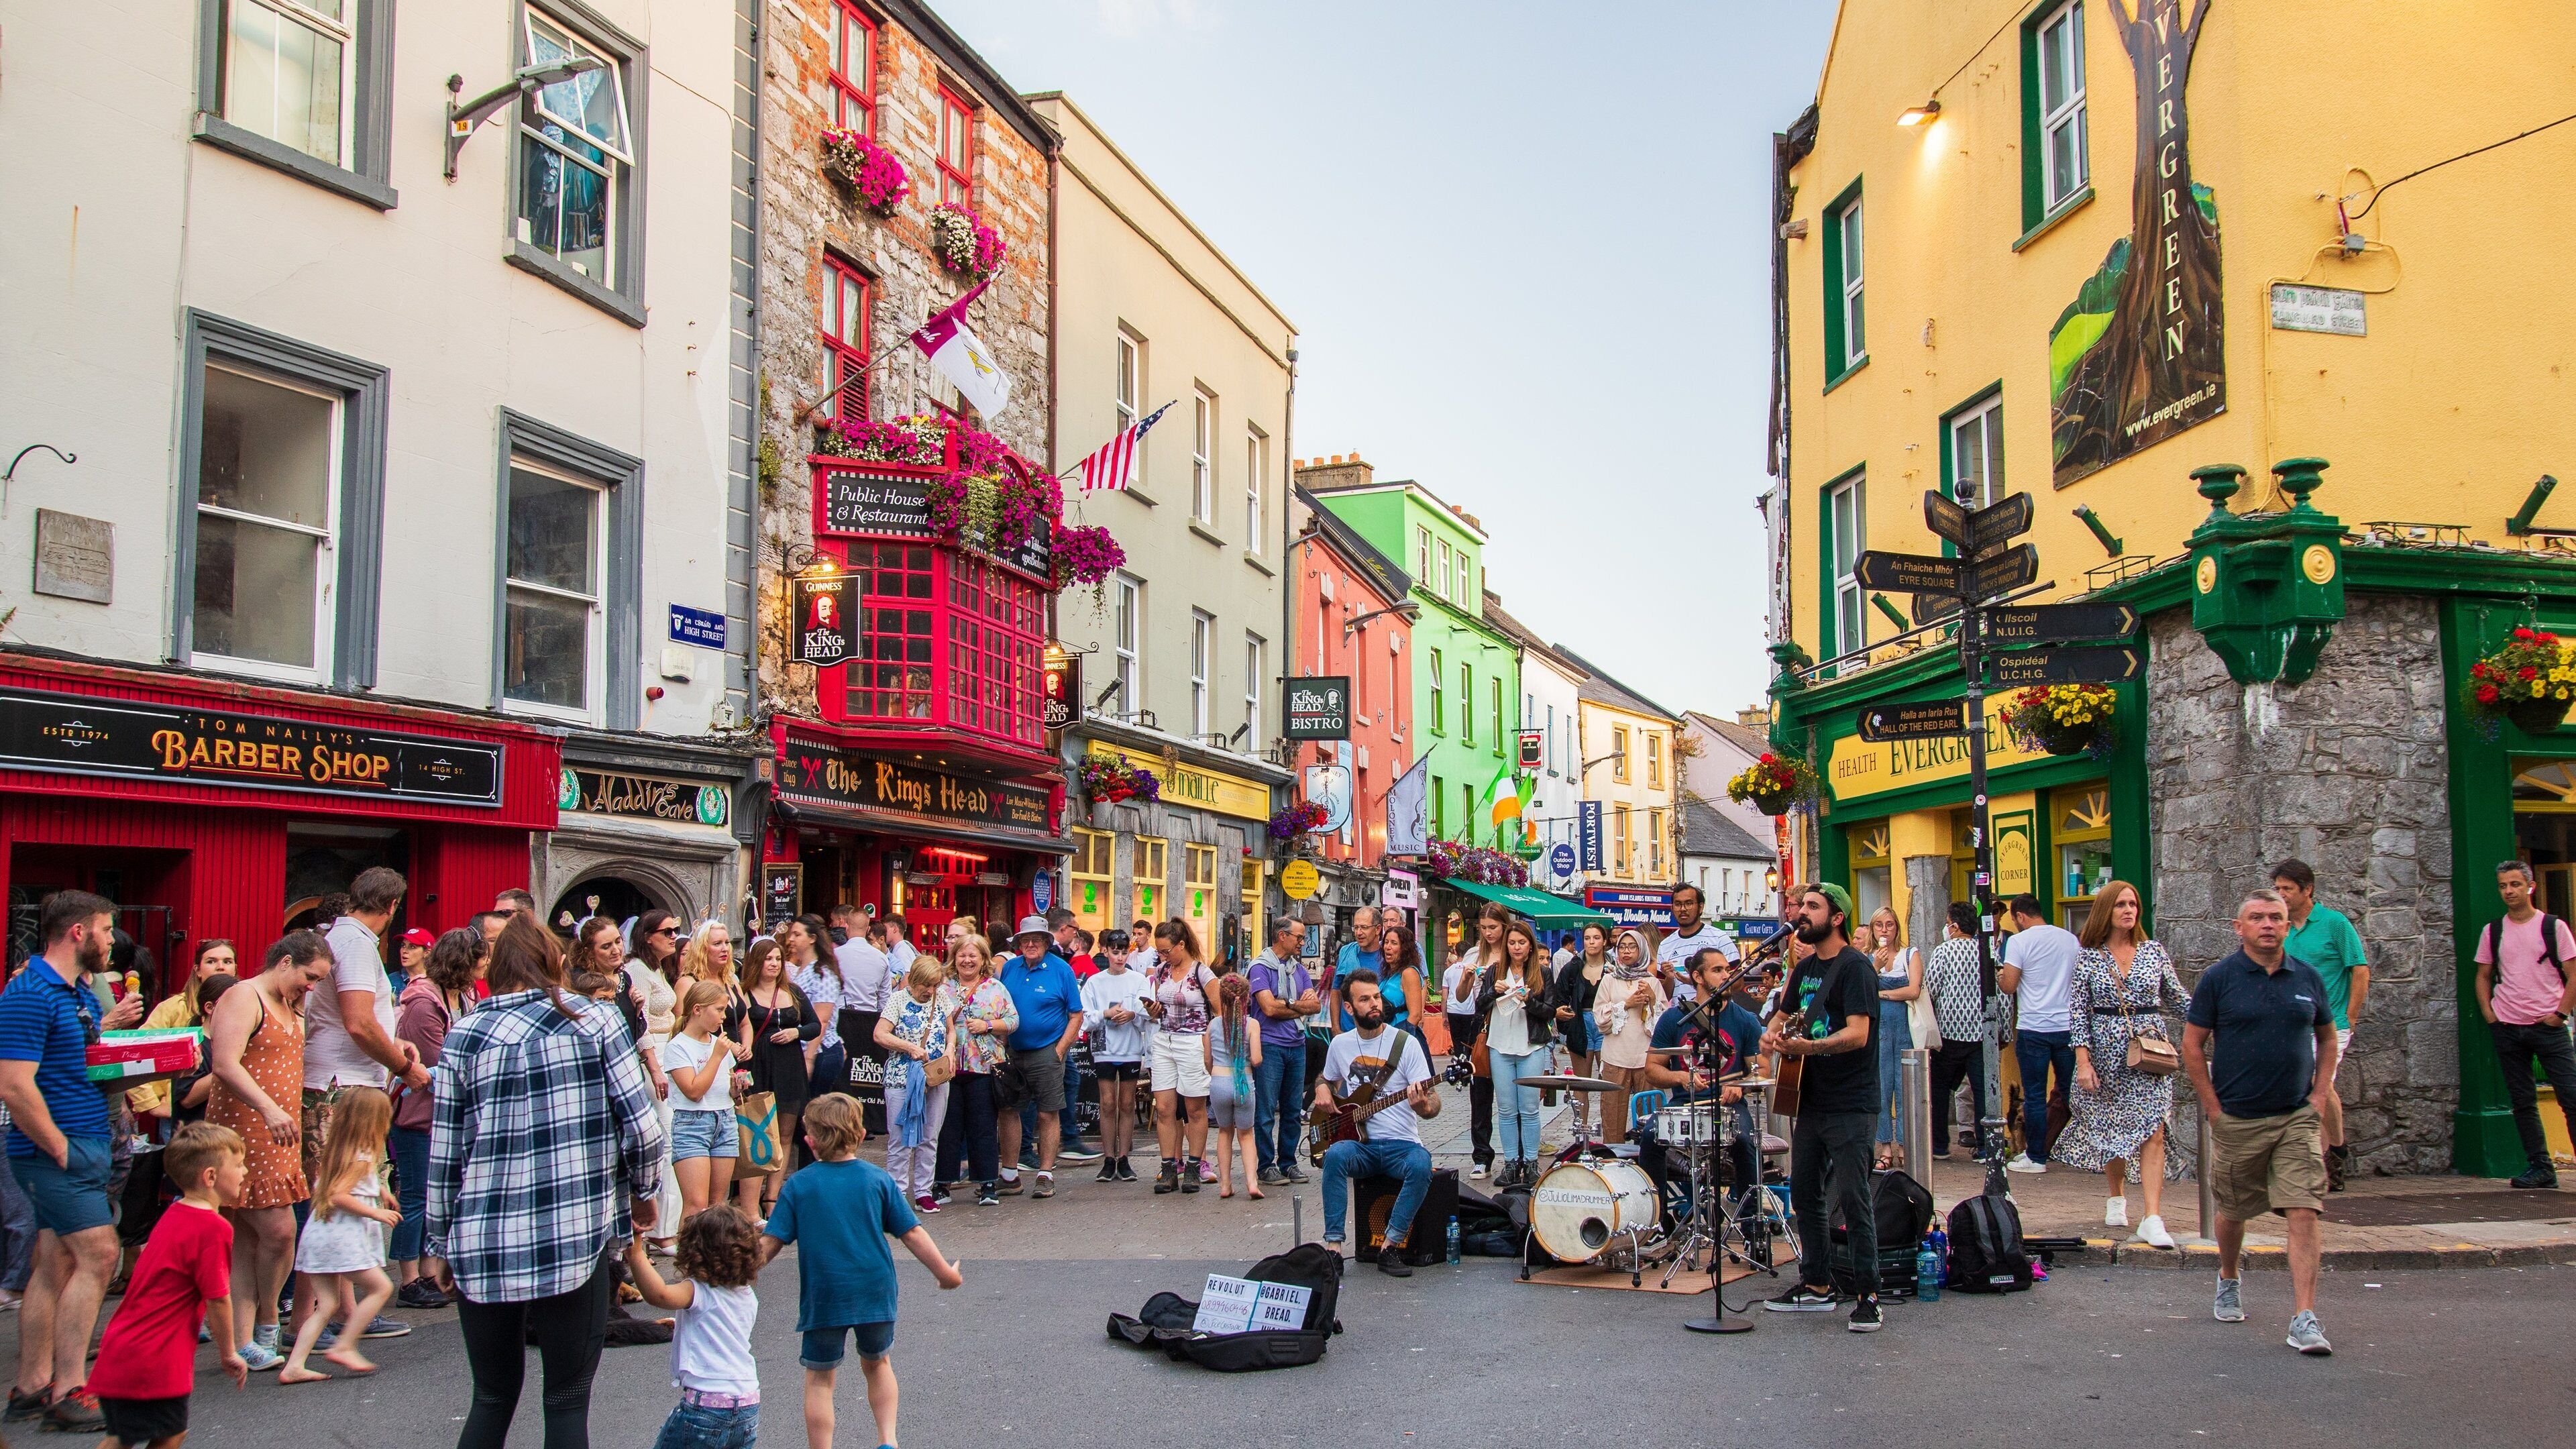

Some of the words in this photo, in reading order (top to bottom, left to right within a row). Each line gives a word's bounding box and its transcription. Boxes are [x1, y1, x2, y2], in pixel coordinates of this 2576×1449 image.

[2153, 0, 2184, 363] VERGREEN
[2125, 380, 2216, 437] www.evergreen.ie
[839, 485, 881, 503] Public
[883, 488, 926, 506] House
[837, 505, 849, 520] &
[851, 504, 929, 525] Restaurant
[1891, 561, 1902, 570] An
[1904, 562, 1933, 573] Fhaiche
[1934, 564, 1953, 575] Mhór
[1899, 575, 1921, 585] EYRE
[1922, 577, 1955, 588] SQUARE
[1998, 570, 2019, 584] WINDOW
[806, 582, 843, 592] GUINNESS
[684, 626, 700, 637] HIGH
[702, 630, 724, 641] STREET
[817, 628, 830, 636] The
[1996, 627, 2037, 637] N.U.I.G.
[804, 646, 842, 657] HEAD
[2000, 655, 2048, 668] Ospidéal
[2000, 669, 2046, 680] U.C.H.G.
[1291, 703, 1321, 712] HEAD
[1900, 710, 1917, 720] Halla
[1918, 710, 1927, 718] an
[1944, 707, 1958, 716] Rua
[1044, 713, 1066, 722] EAD
[1291, 717, 1343, 729] BISTRO
[199, 718, 246, 733] TOM
[266, 726, 352, 745] NALLY'S
[1880, 724, 1898, 734] HALL
[1898, 723, 1908, 733] OF
[1909, 722, 1923, 731] THE
[1924, 720, 1937, 730] RED
[1939, 719, 1958, 729] EARL
[80, 731, 109, 740] 1974
[1890, 711, 2019, 777] EVERGREN
[152, 730, 303, 772] BARBER
[310, 745, 390, 784] SHOP
[431, 765, 450, 773] HIGH
[1838, 753, 1876, 778] HEALTH
[784, 771, 796, 787] 1649
[826, 758, 862, 794] The
[875, 761, 931, 812] Kings
[941, 775, 987, 814] Head
[583, 773, 679, 814] Aladdin's
[654, 796, 694, 820] Cave
[2000, 840, 2029, 863] EVERGREEN
[2000, 868, 2029, 881] CORNER
[1624, 909, 1649, 922] Woollen
[1650, 910, 1671, 923] Market
[1745, 924, 1761, 934] GALWAY
[1762, 924, 1773, 934] GIFTS
[850, 1071, 881, 1083] HEAD
[1208, 1279, 1245, 1295] REVOLUT
[1260, 1286, 1301, 1304] @GABRIEL.
[1265, 1306, 1291, 1322] BREAD.
